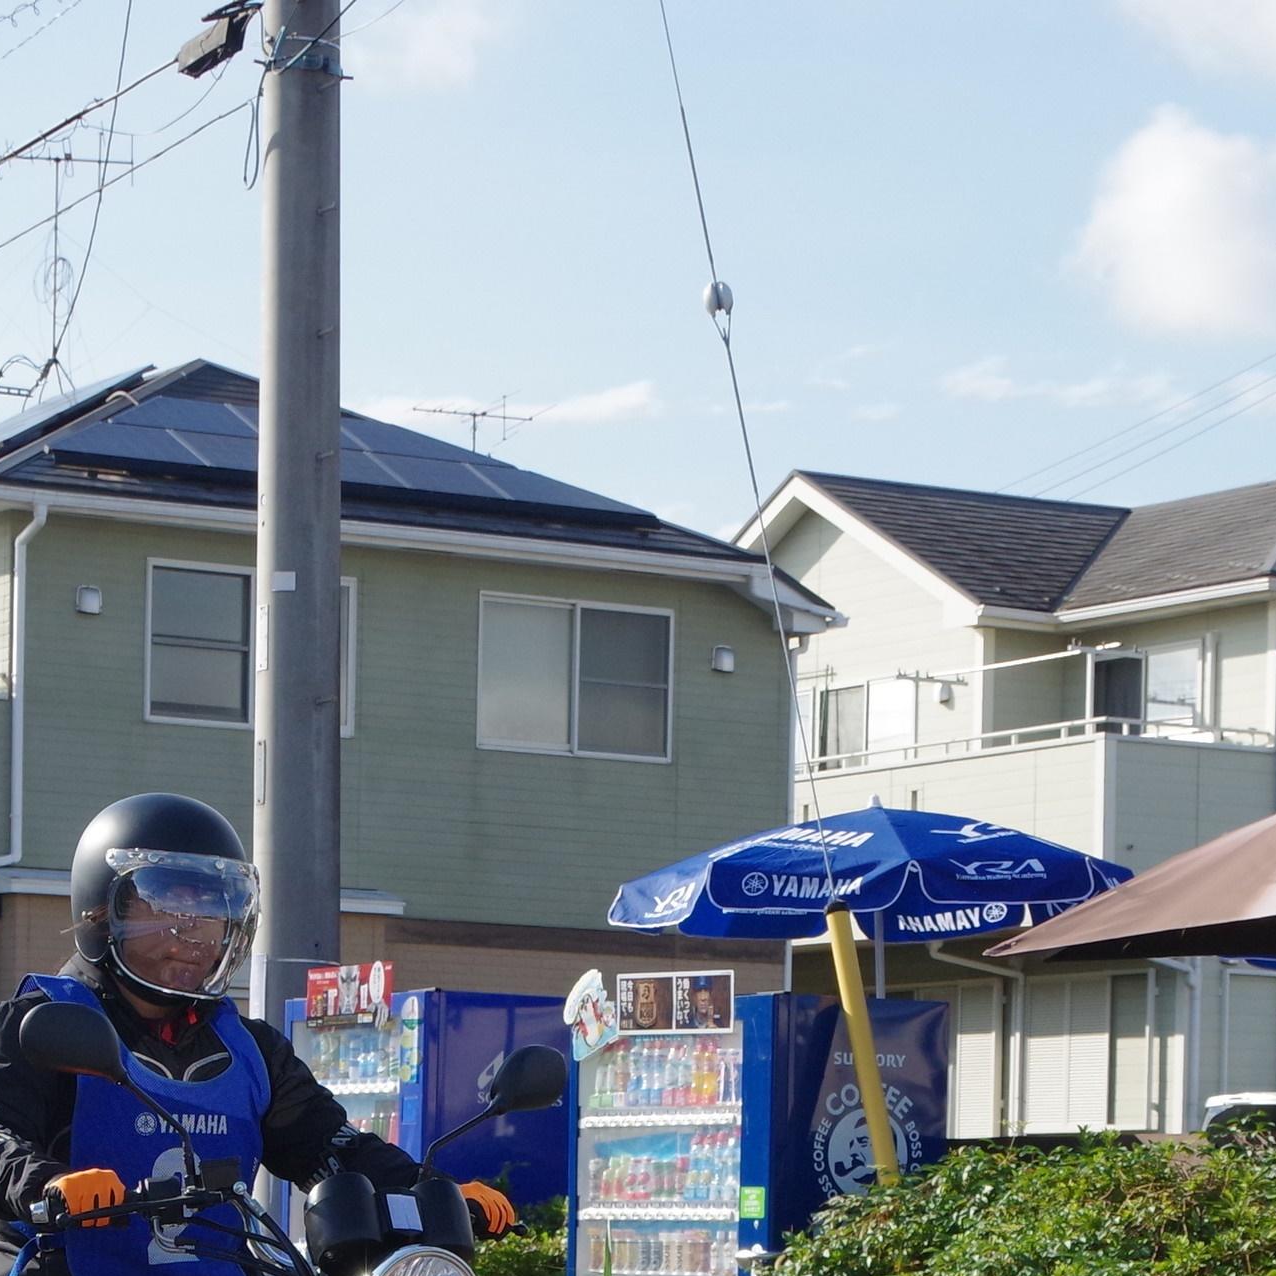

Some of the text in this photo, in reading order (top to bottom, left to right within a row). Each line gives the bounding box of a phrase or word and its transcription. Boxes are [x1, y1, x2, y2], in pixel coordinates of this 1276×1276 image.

[772, 874, 865, 899] YAMAHA
[813, 1118, 832, 1172] COFFEE
[905, 1120, 923, 1159] BOSS
